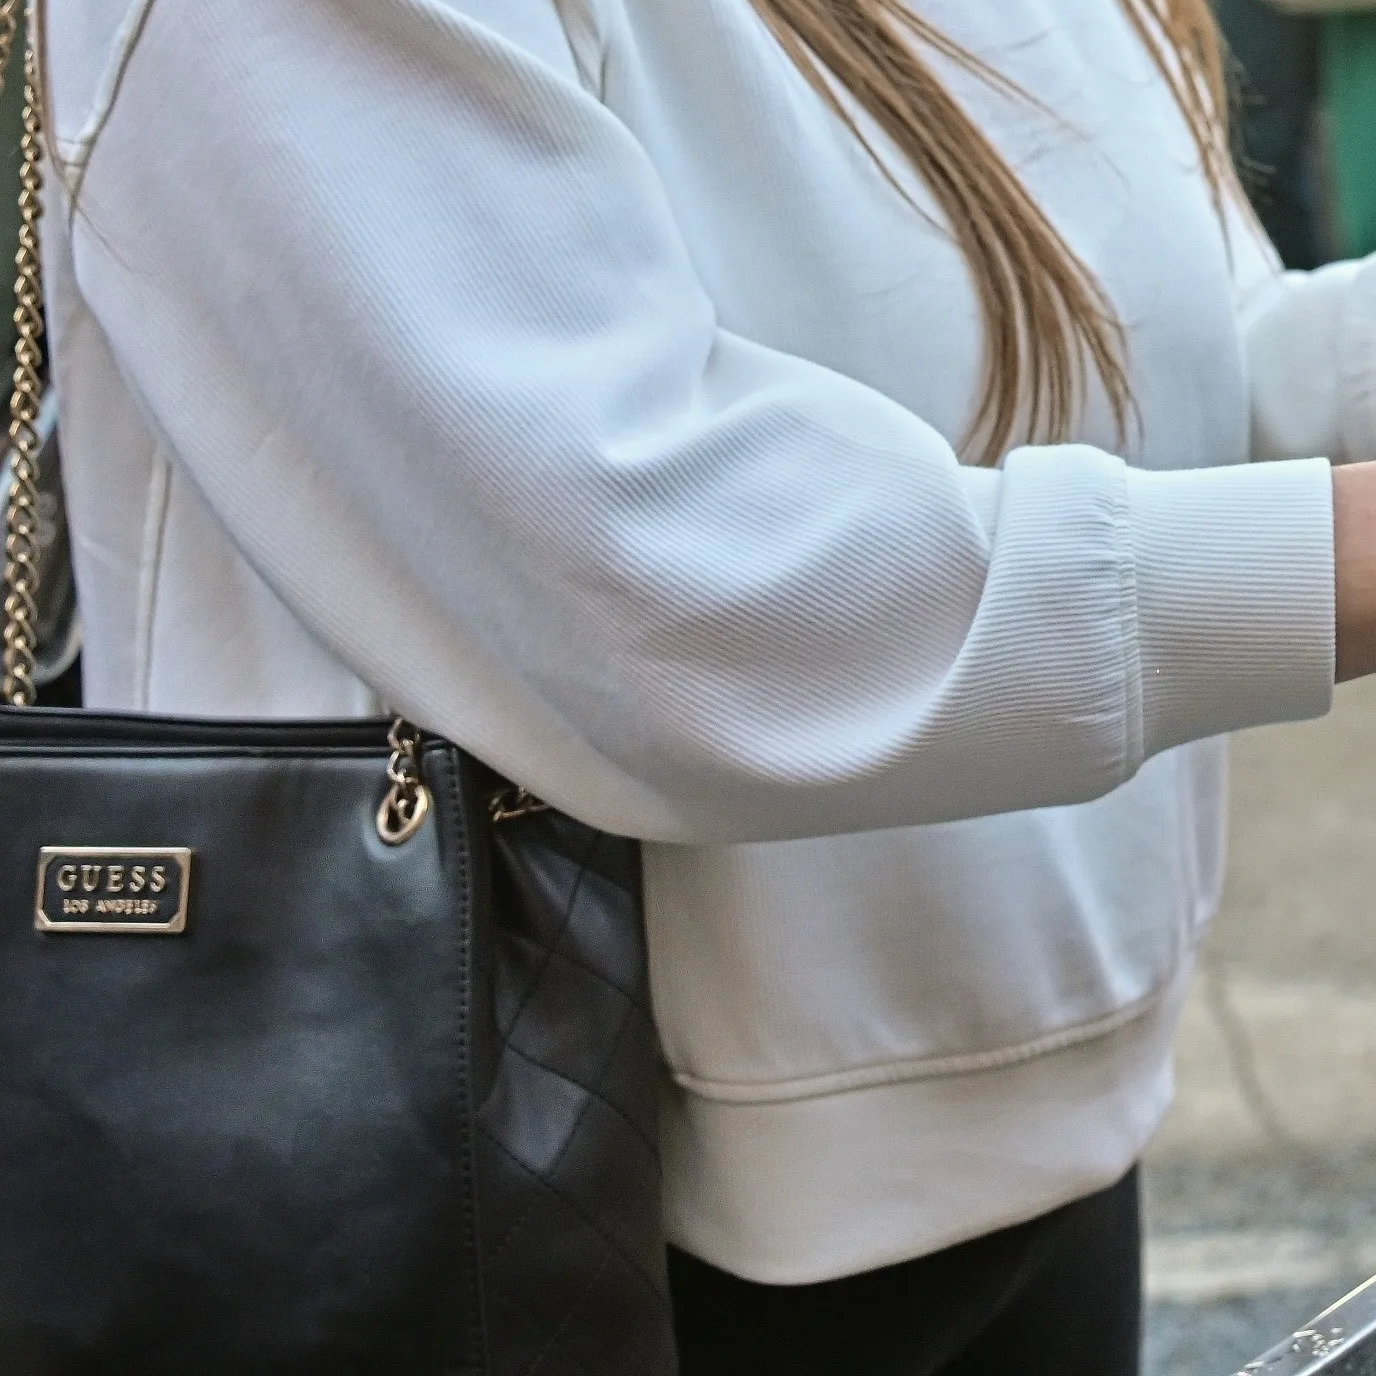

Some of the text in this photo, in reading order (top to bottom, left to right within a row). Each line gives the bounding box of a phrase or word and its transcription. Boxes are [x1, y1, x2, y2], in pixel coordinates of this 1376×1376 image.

[57, 864, 167, 893] GUESS
[63, 898, 160, 915] LOS ANGELES
